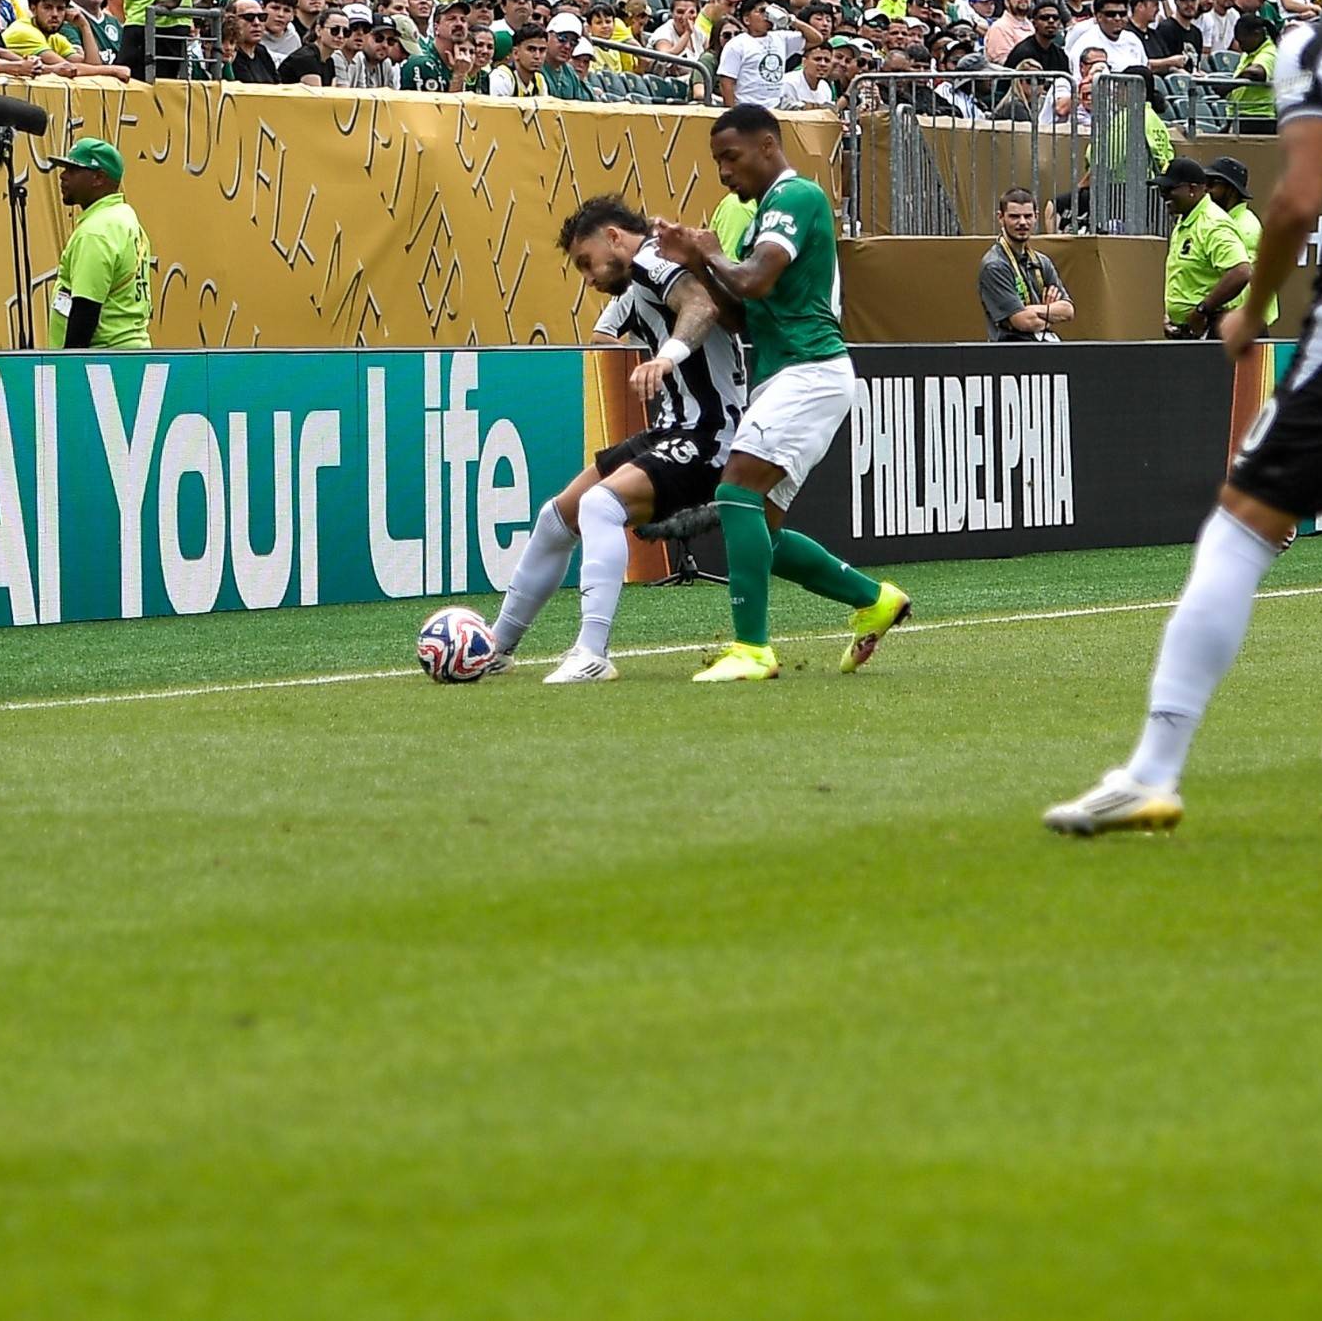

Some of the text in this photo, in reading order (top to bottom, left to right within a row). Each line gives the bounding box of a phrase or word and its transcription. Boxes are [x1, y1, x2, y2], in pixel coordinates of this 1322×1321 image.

[85, 363, 341, 619] Your
[366, 352, 531, 599] Life
[850, 372, 1075, 539] PHILADELPHIA
